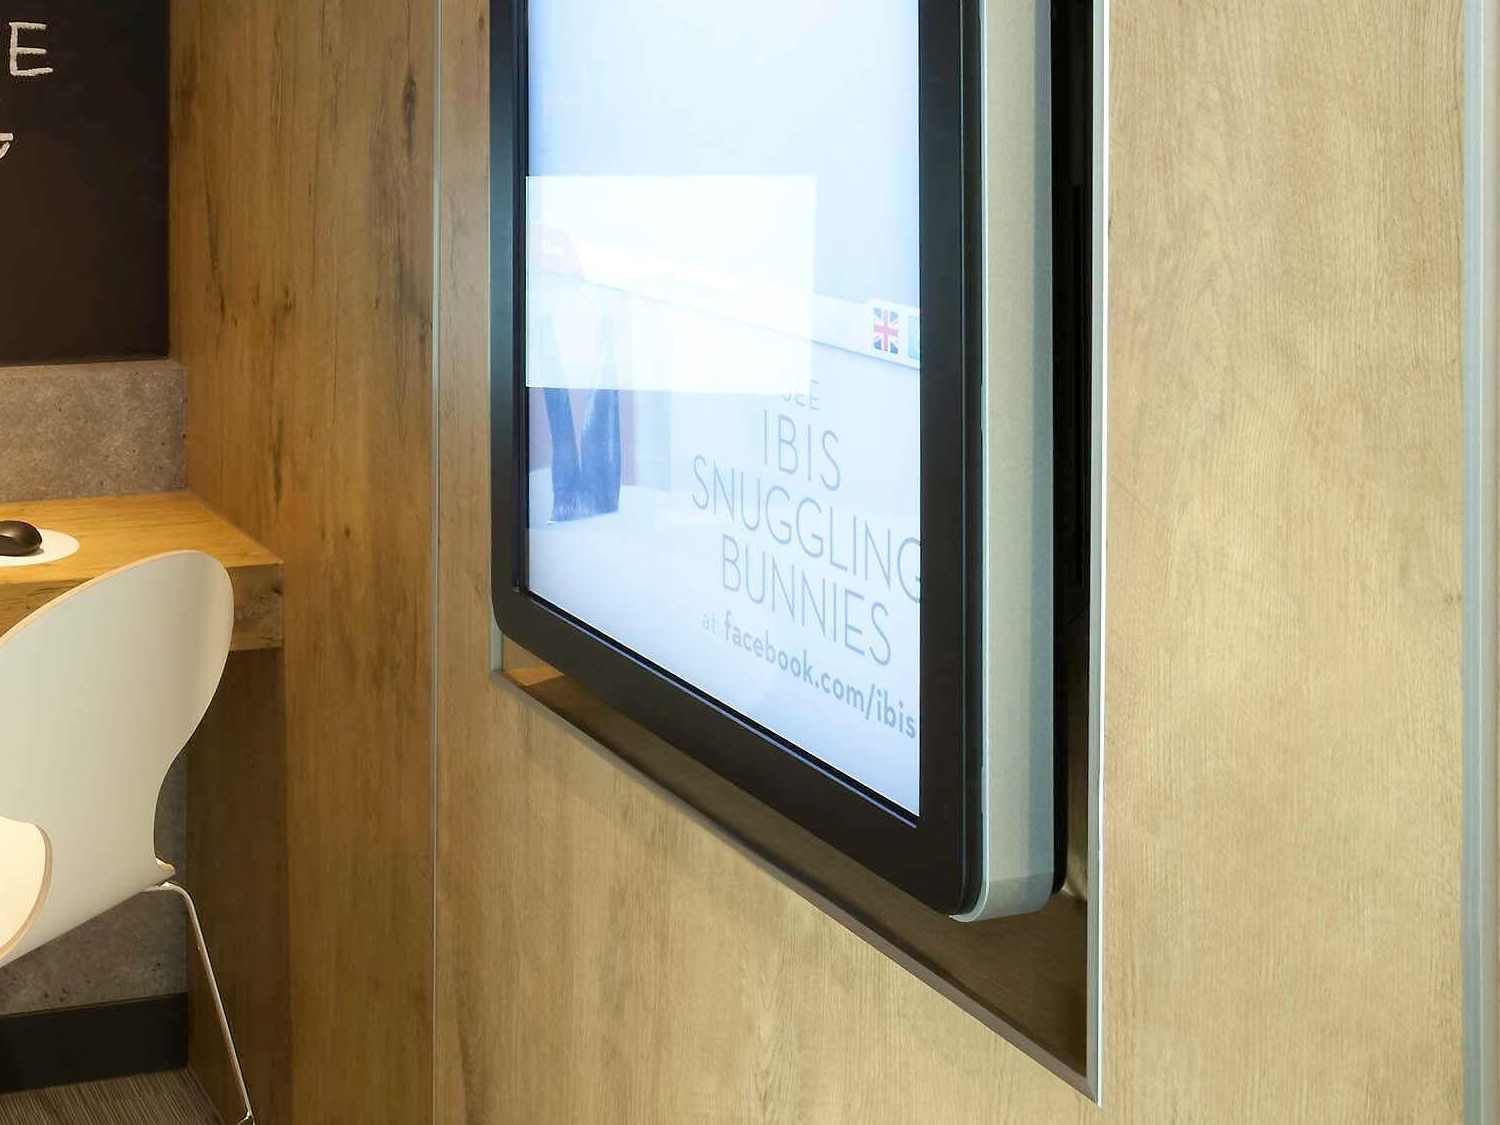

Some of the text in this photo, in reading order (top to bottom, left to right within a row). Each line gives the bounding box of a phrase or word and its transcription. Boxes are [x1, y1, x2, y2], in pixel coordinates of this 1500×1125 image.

[763, 408, 841, 492] IBIS
[692, 454, 921, 604] SNUGGLING
[722, 533, 892, 667] BUNNIES
[701, 609, 916, 739] at facebook.com/ibis
